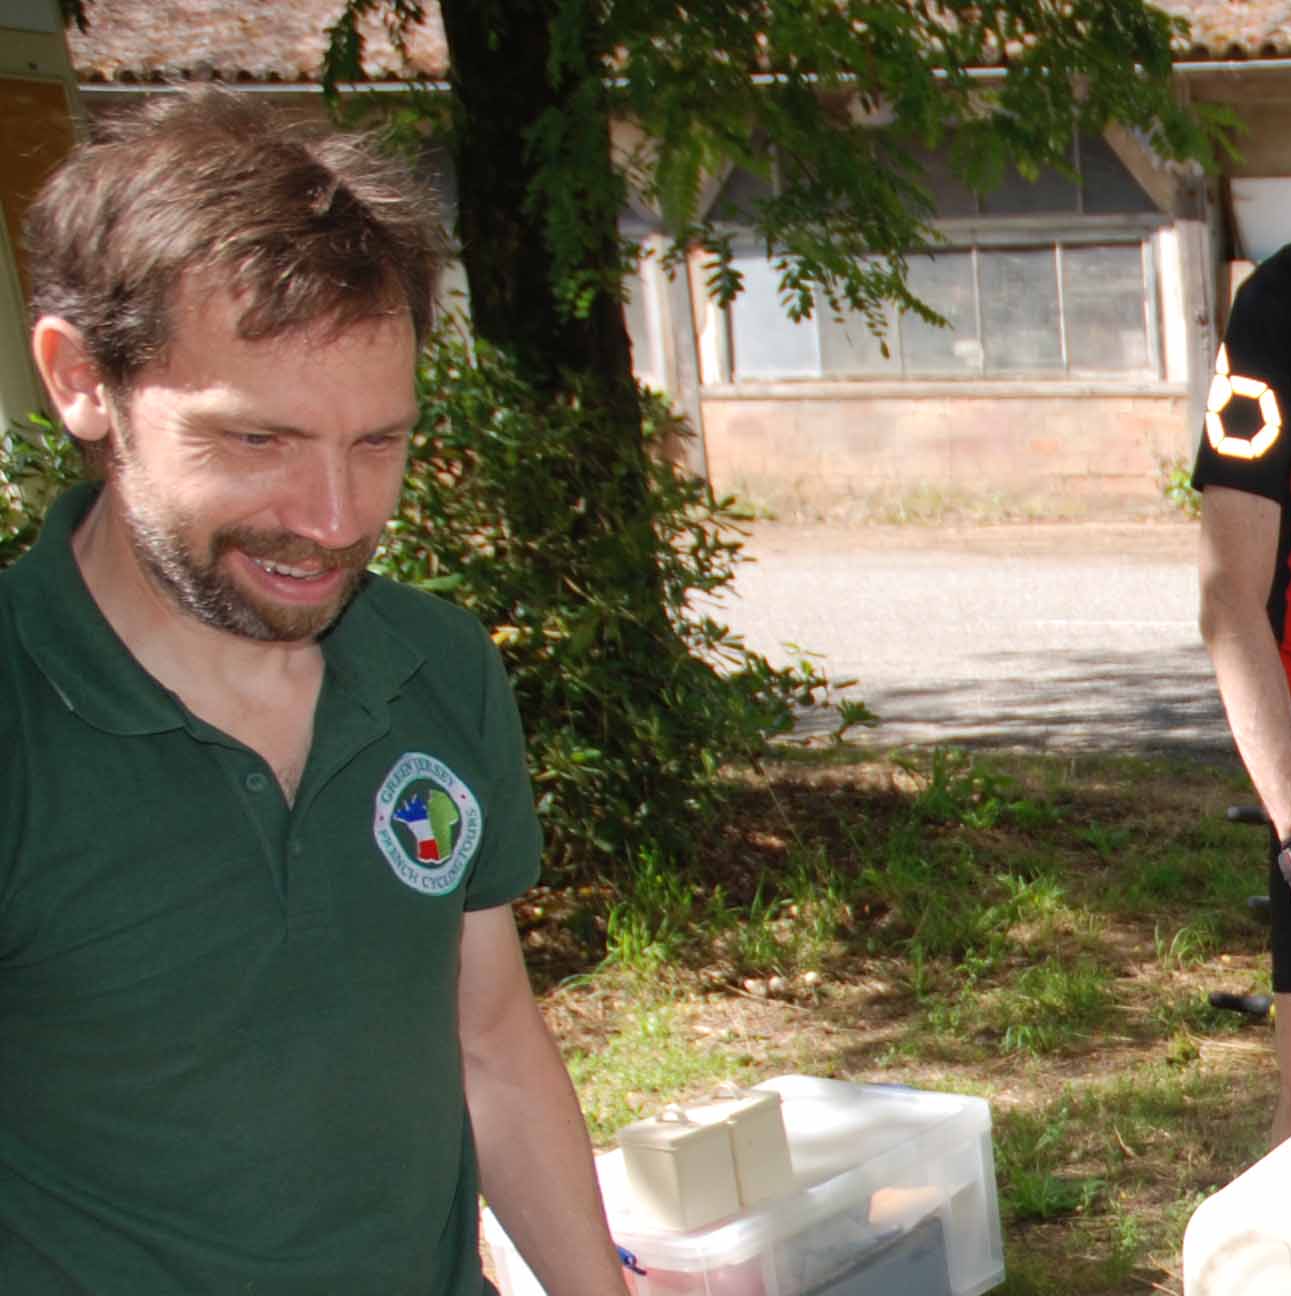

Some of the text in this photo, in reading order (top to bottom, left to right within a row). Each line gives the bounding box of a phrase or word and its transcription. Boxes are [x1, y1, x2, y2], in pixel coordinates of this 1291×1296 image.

[380, 758, 414, 804] GREEN
[380, 807, 478, 890] FRENCH CYCLING TOURS
